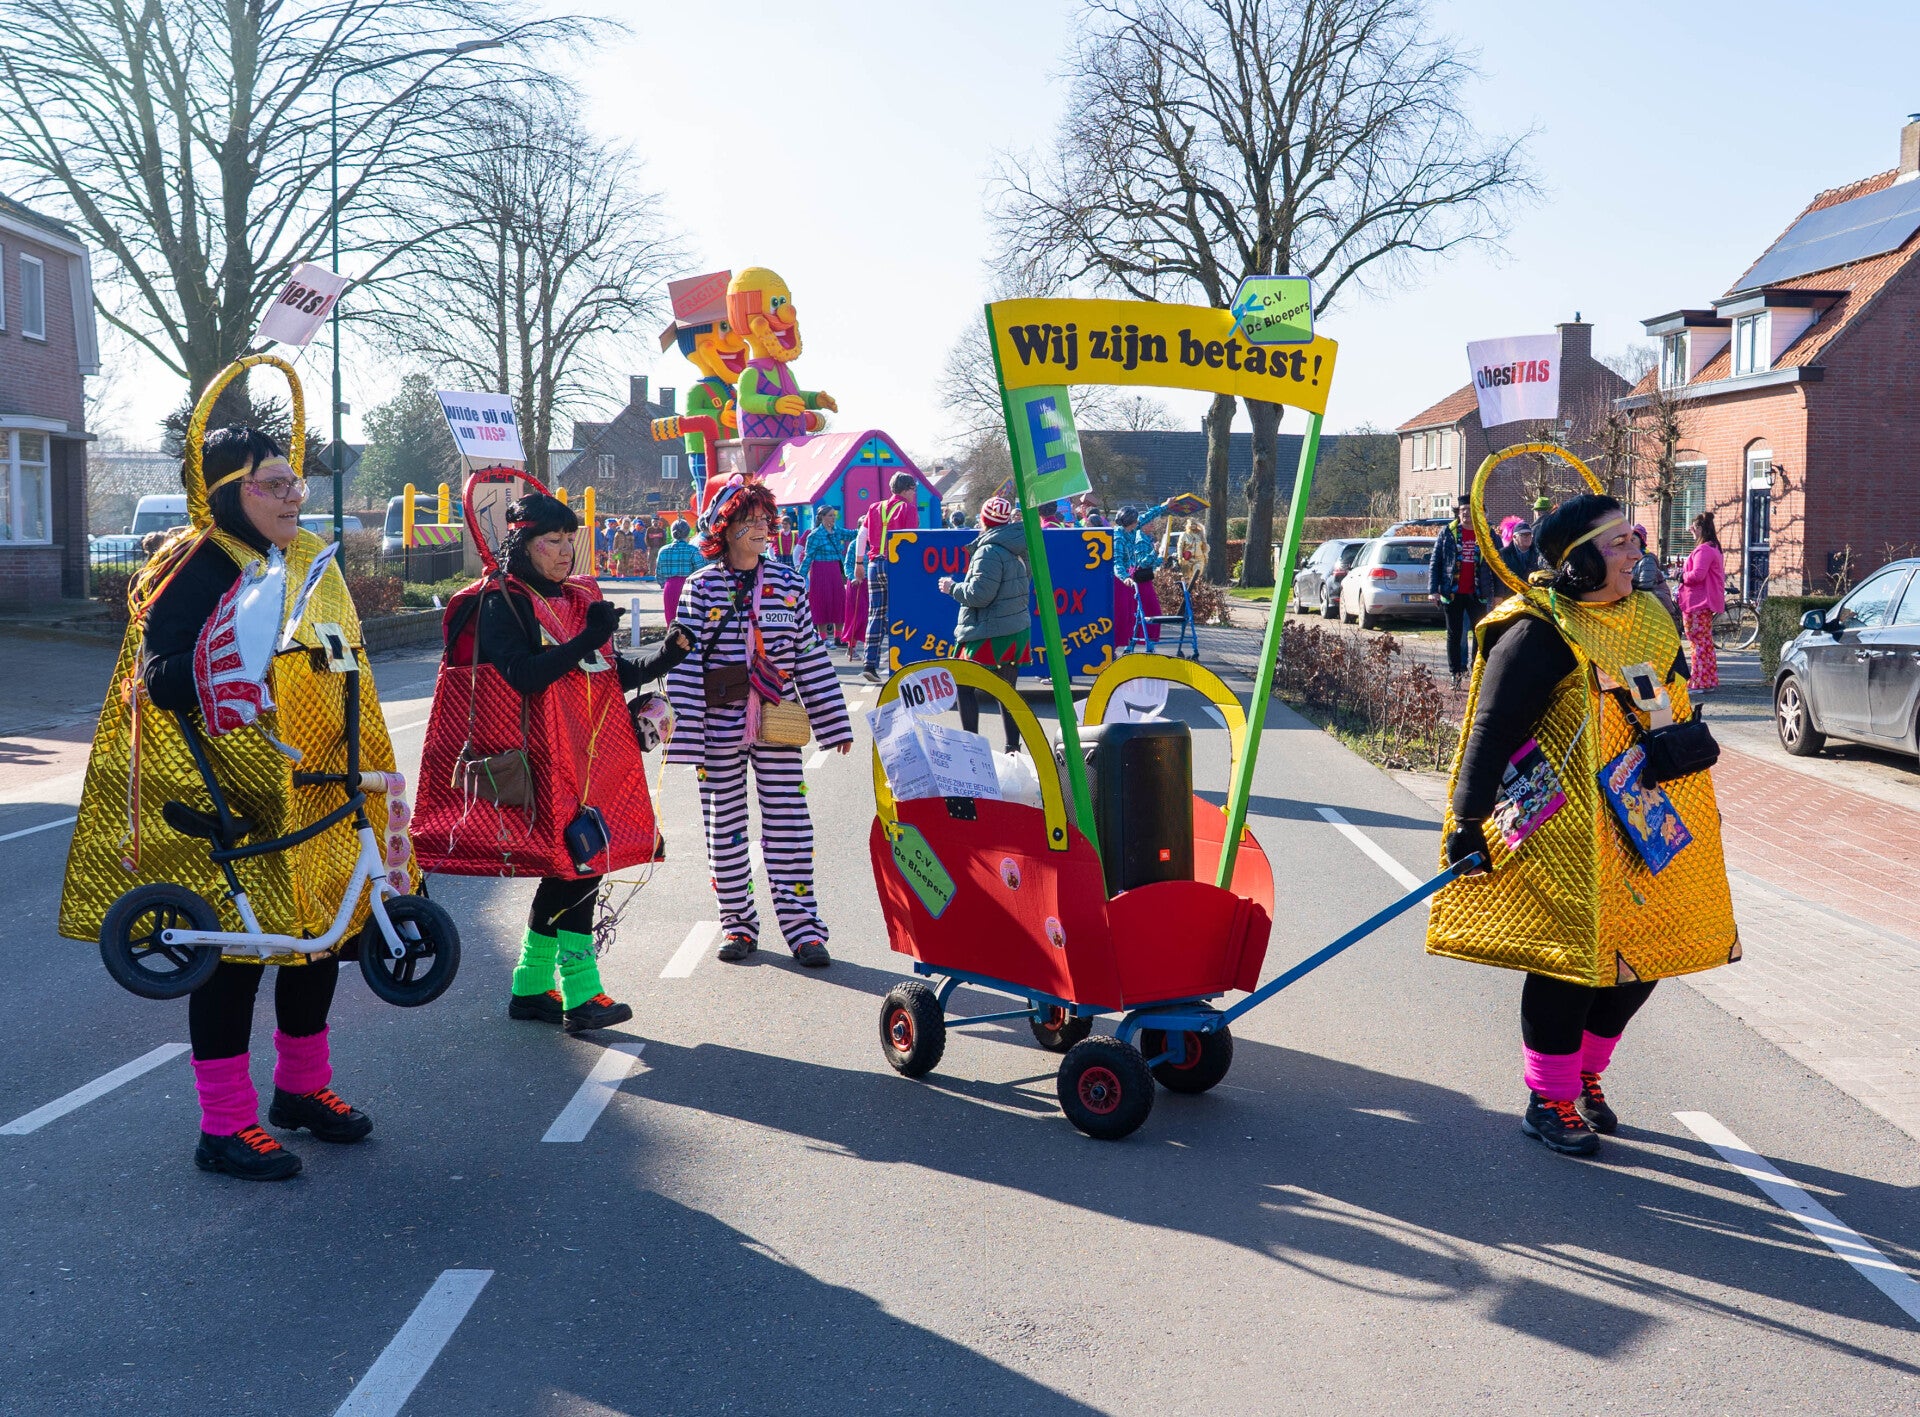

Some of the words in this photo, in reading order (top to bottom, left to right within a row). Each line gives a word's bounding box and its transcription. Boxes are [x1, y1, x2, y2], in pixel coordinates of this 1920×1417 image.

[1262, 290, 1287, 307] C.V.
[1263, 302, 1310, 328] Bloepers
[1008, 323, 1078, 371] Wij
[1088, 325, 1168, 371] zijn
[1178, 328, 1323, 386] betast!
[444, 405, 480, 422] Wilde
[482, 409, 498, 425] gij
[501, 410, 515, 425] ok
[459, 426, 475, 440] un
[476, 426, 506, 442] TAS?
[1025, 396, 1067, 476] E
[1085, 541, 1101, 570] 3
[890, 619, 917, 642] CV
[915, 849, 933, 872] C.V.
[894, 845, 906, 863] De
[908, 859, 948, 902] Bloepers
